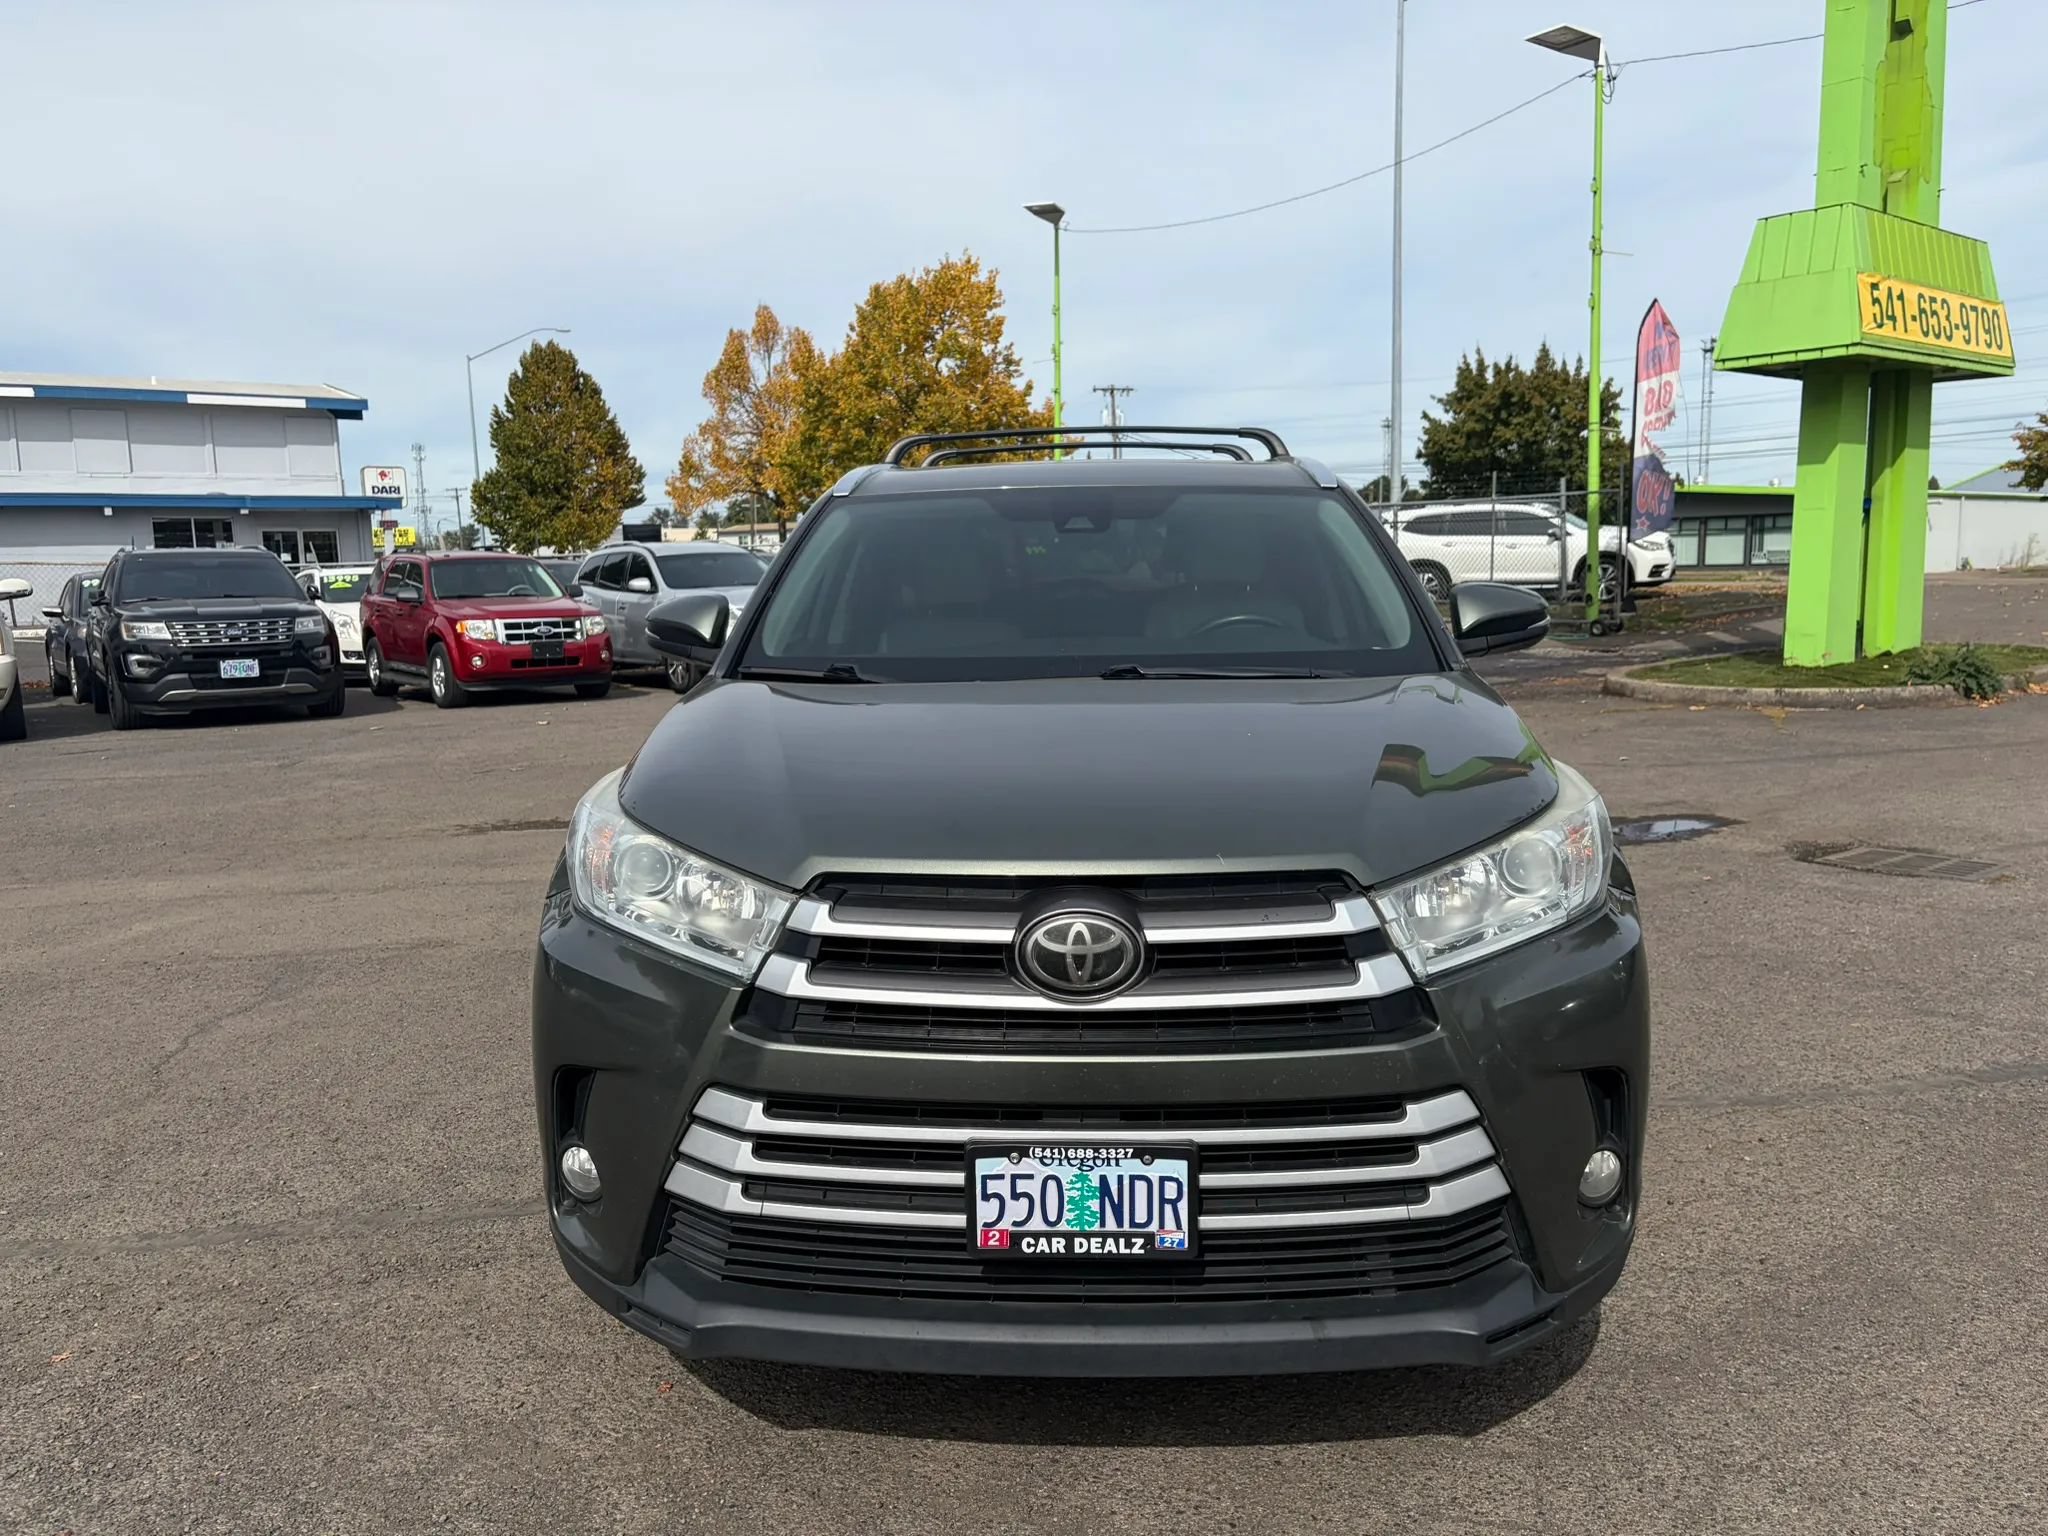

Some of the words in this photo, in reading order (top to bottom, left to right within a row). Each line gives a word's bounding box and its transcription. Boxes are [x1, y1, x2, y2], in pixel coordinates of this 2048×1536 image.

[1870, 282, 2003, 351] 541-653-9790
[371, 485, 400, 495] DARI
[1636, 469, 1673, 517] OK!
[1029, 1146, 1066, 1159] (541)
[1067, 1147, 1134, 1159] 688-3327
[981, 1174, 1065, 1228] 550
[1099, 1174, 1184, 1230] NDR
[987, 1230, 1000, 1246] 2
[1021, 1237, 1067, 1254] CAR
[1074, 1237, 1145, 1254] DEALZ
[1163, 1237, 1180, 1248] 27
